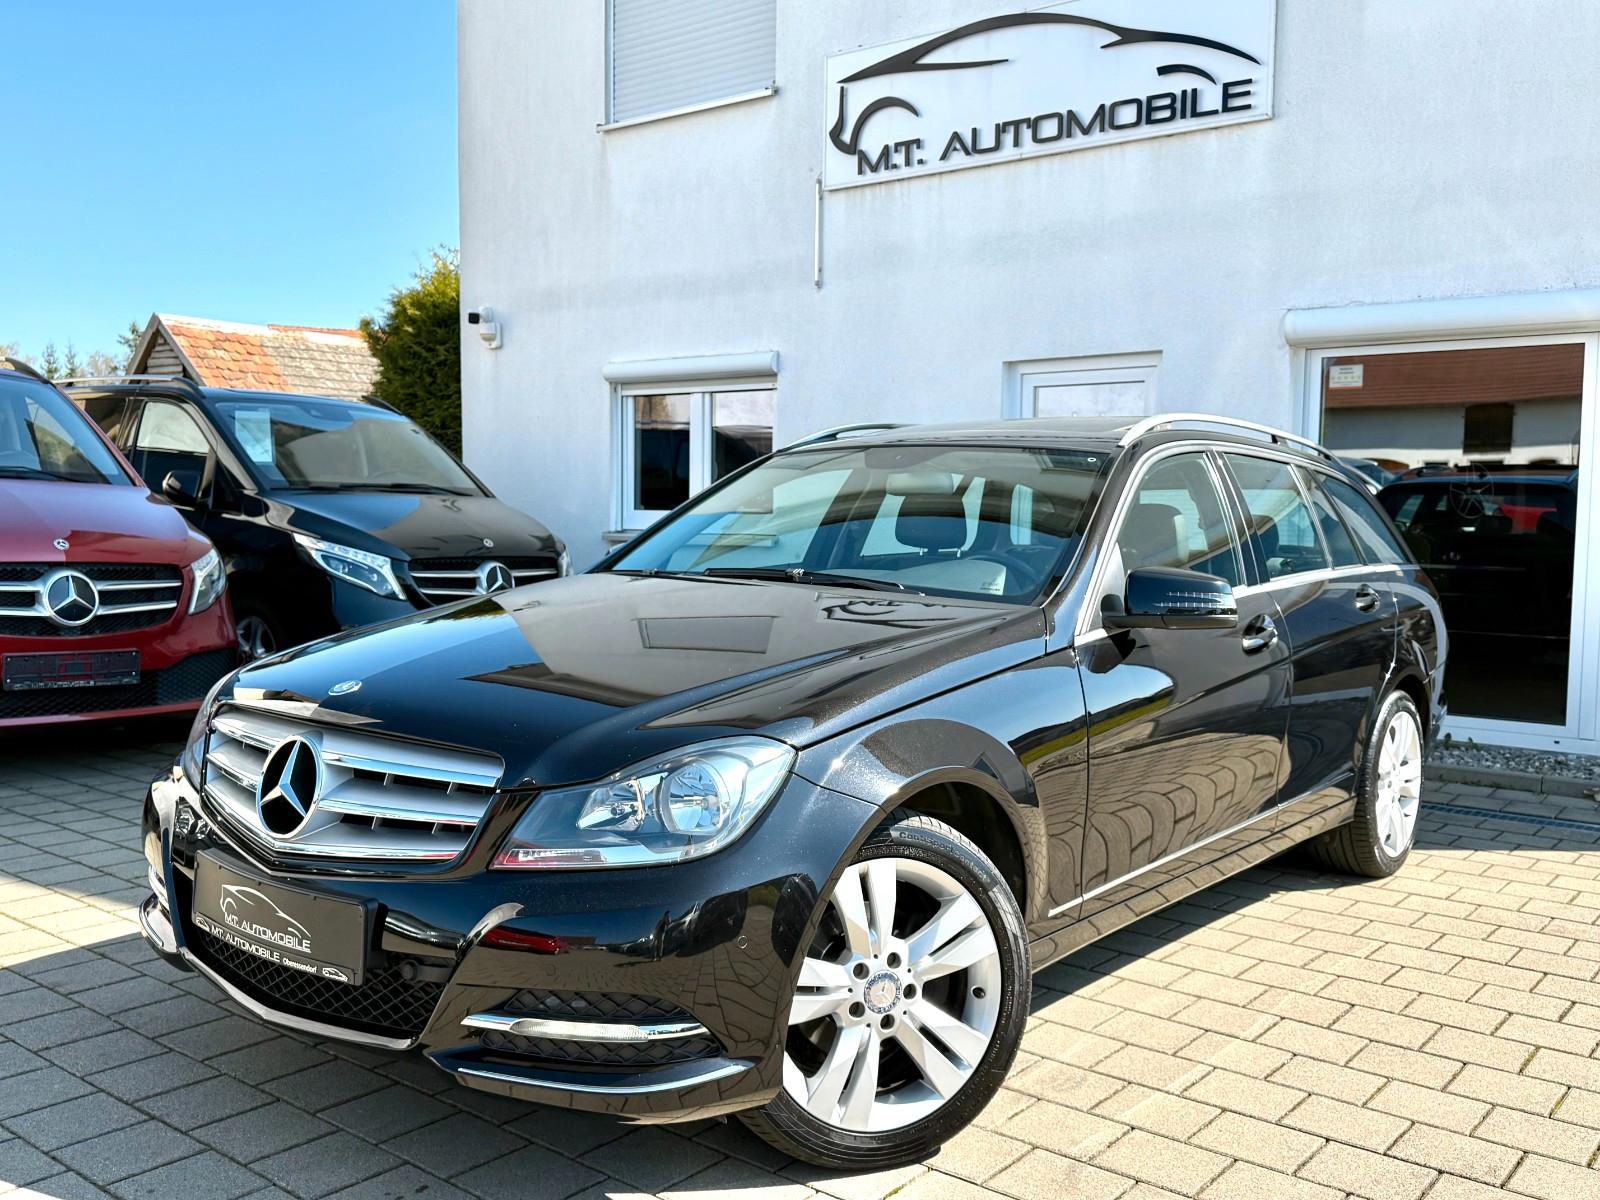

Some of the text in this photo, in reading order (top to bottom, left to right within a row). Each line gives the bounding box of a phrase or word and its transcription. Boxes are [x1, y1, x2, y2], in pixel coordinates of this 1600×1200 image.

[857, 78, 1253, 175] M.T. AUTOMOBILE
[226, 933, 281, 962] AUTOMOBILE
[241, 920, 311, 951] AUTOMOBILE
